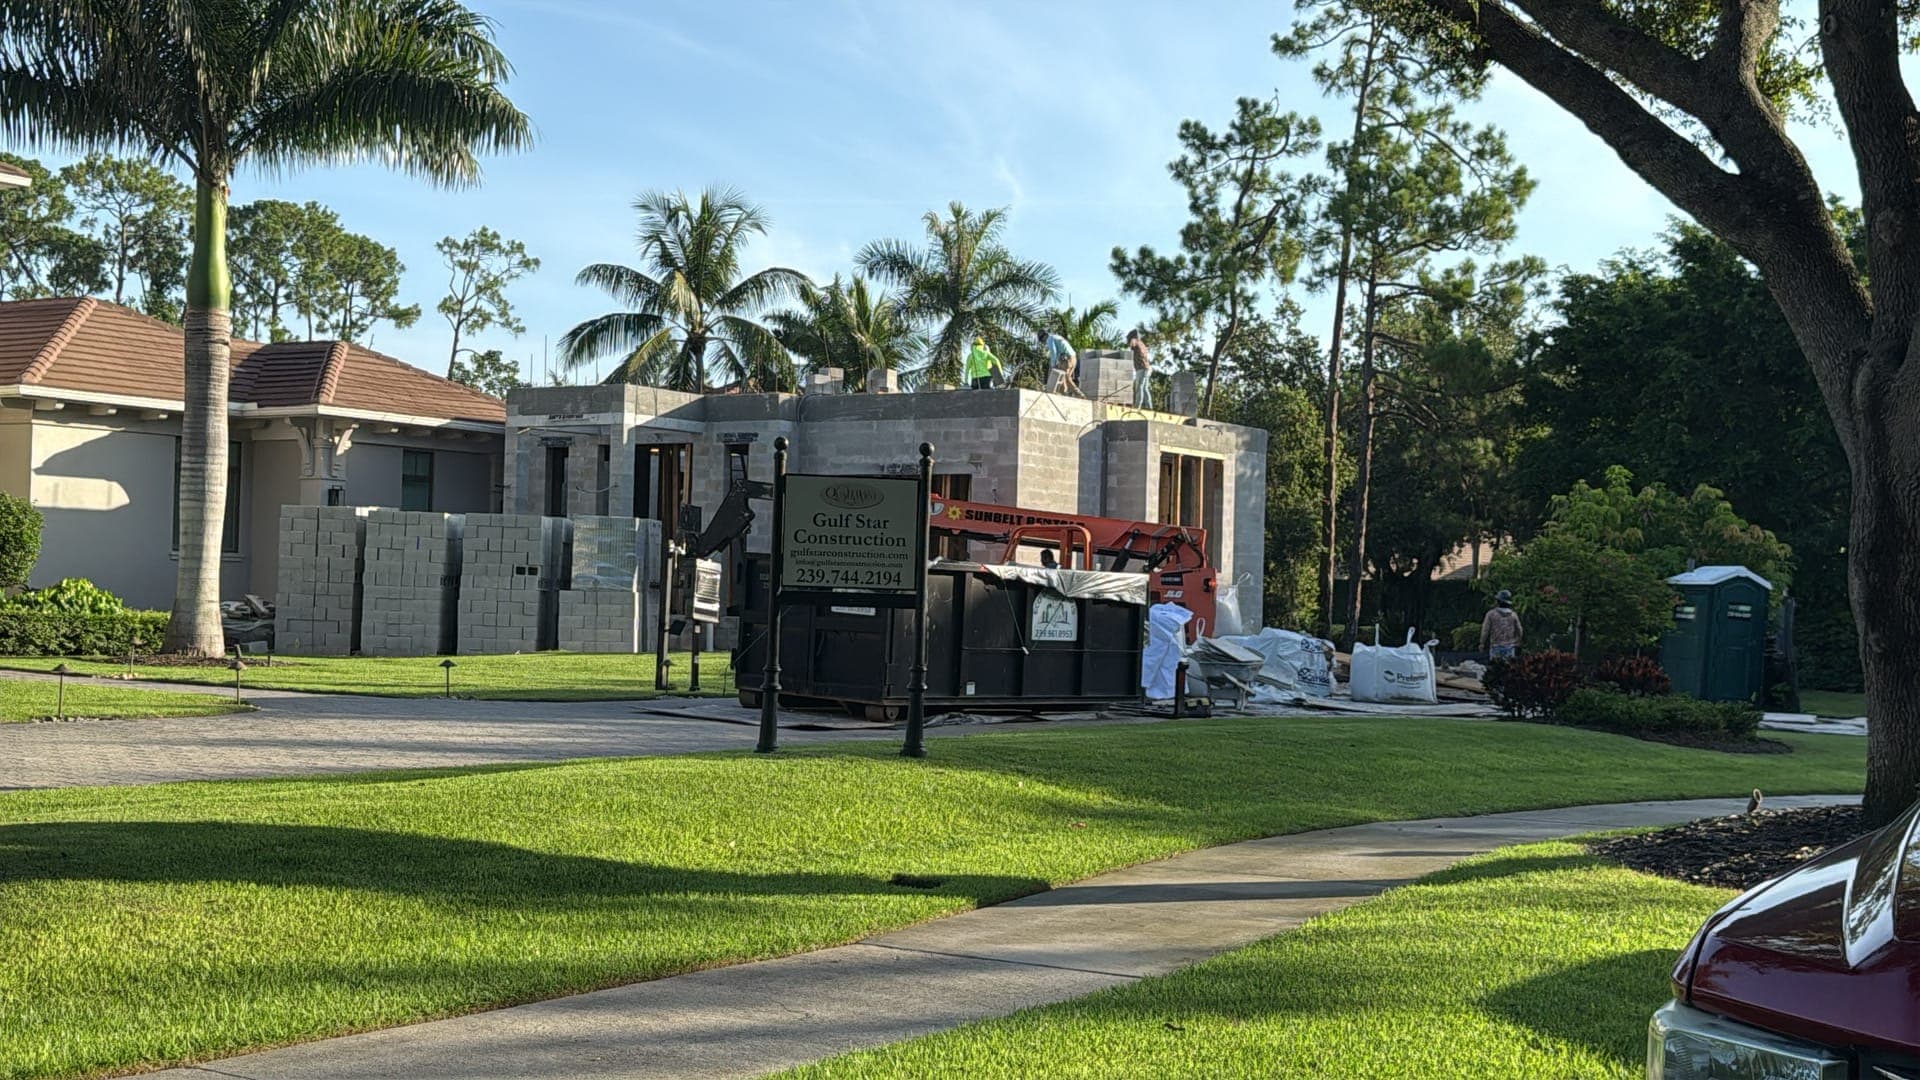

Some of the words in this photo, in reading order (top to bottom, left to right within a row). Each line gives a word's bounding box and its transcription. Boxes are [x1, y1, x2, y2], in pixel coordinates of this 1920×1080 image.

[812, 512, 852, 528] Gulf
[855, 514, 890, 530] Star
[965, 509, 1024, 526] SUNBELT
[793, 529, 907, 547] Construction
[790, 547, 909, 560] gulfstarconstruction.com
[796, 568, 902, 586] 239.744.2194
